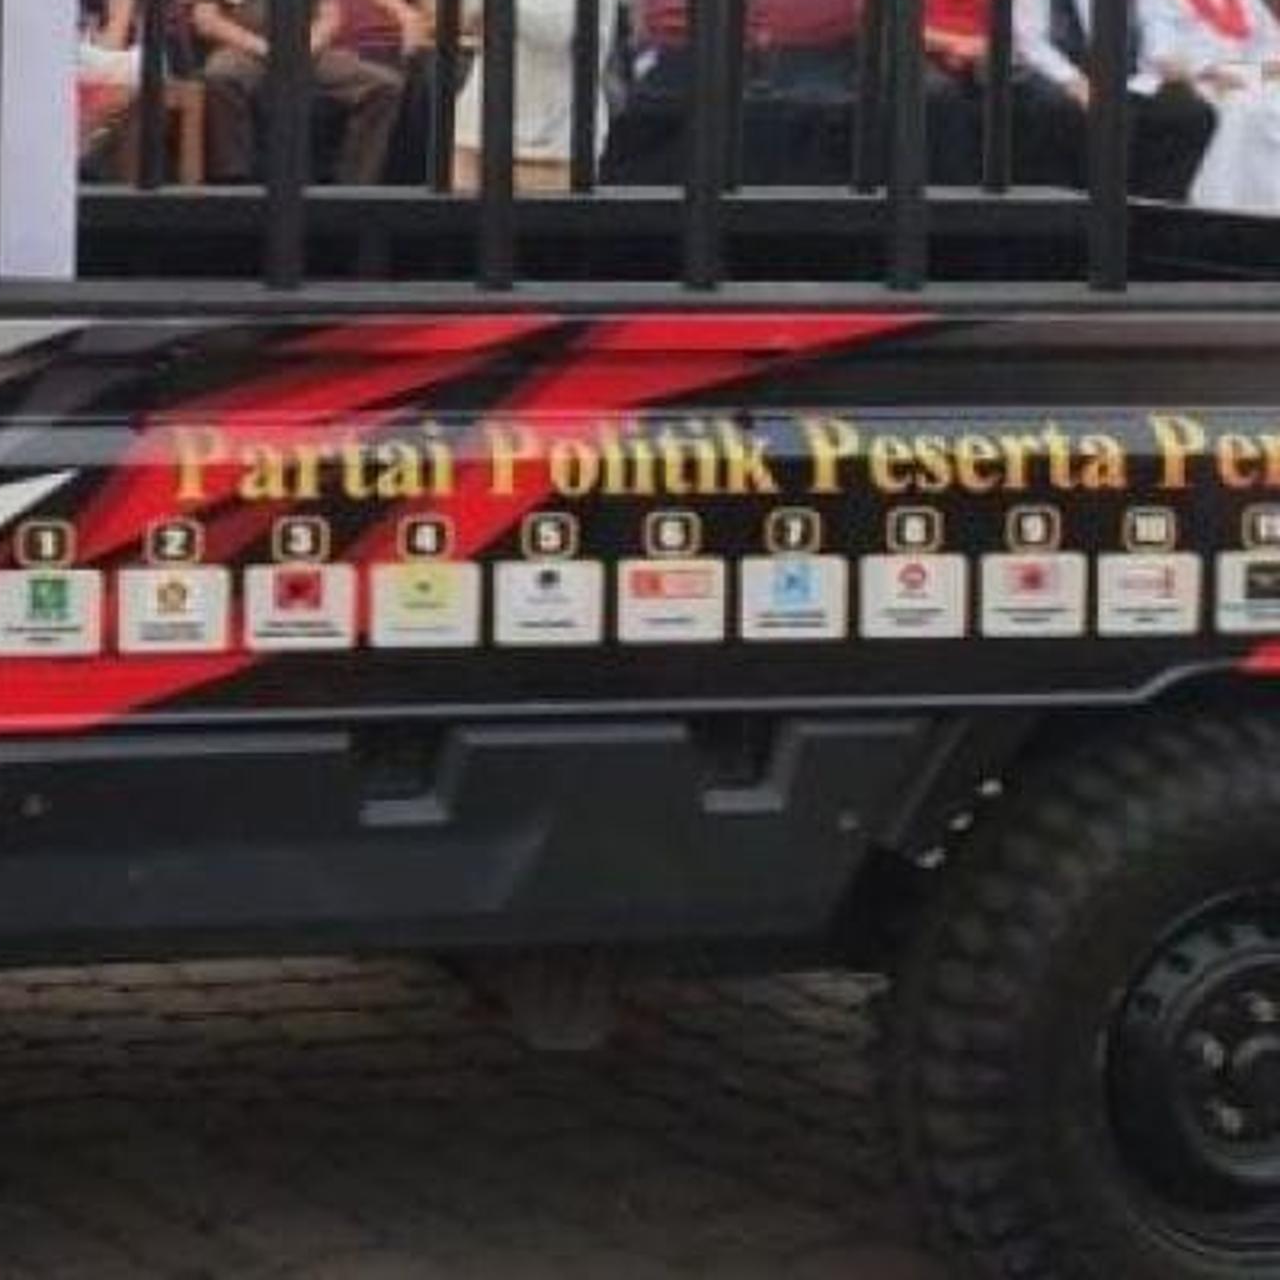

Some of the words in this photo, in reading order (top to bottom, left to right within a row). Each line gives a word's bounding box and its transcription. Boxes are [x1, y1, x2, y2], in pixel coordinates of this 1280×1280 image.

[170, 418, 454, 500] Partai
[482, 417, 778, 497] Politik
[802, 415, 1130, 494] Peserta
[38, 530, 55, 557] 1
[165, 529, 190, 556] 2
[289, 524, 312, 553] 3
